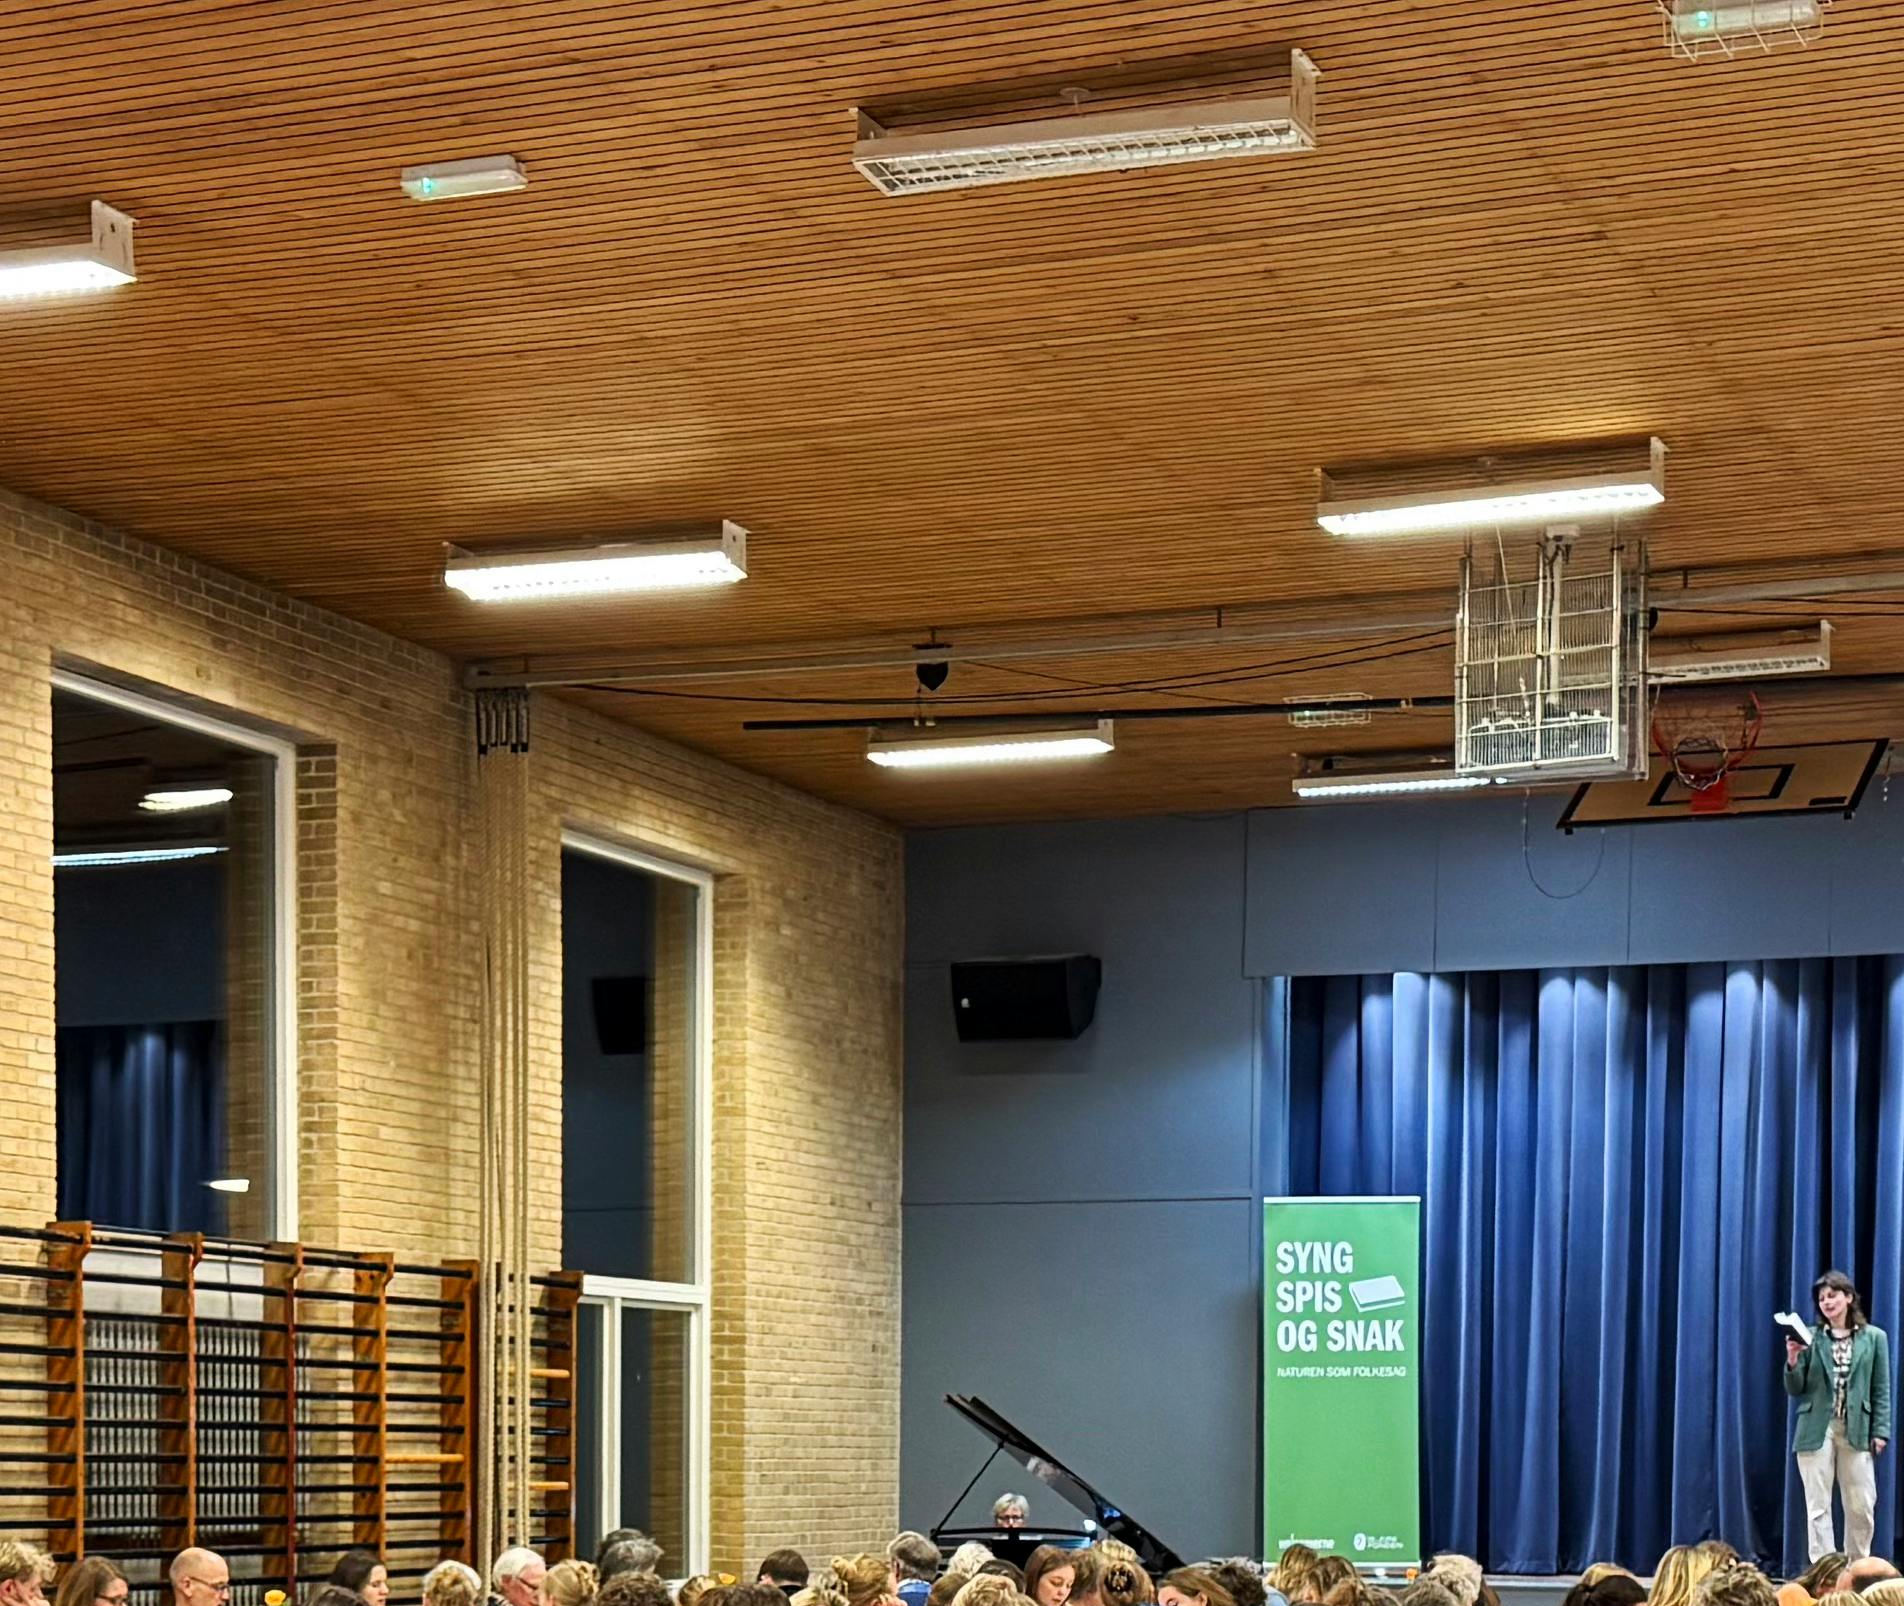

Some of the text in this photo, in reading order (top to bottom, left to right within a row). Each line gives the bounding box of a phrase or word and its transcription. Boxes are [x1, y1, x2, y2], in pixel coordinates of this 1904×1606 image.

[1276, 1241, 1354, 1274] SYNG
[1276, 1280, 1343, 1313] SPIS
[1277, 1319, 1405, 1352] OG SNAK
[1276, 1366, 1407, 1378] NATUREN SOM FOLKESAG
